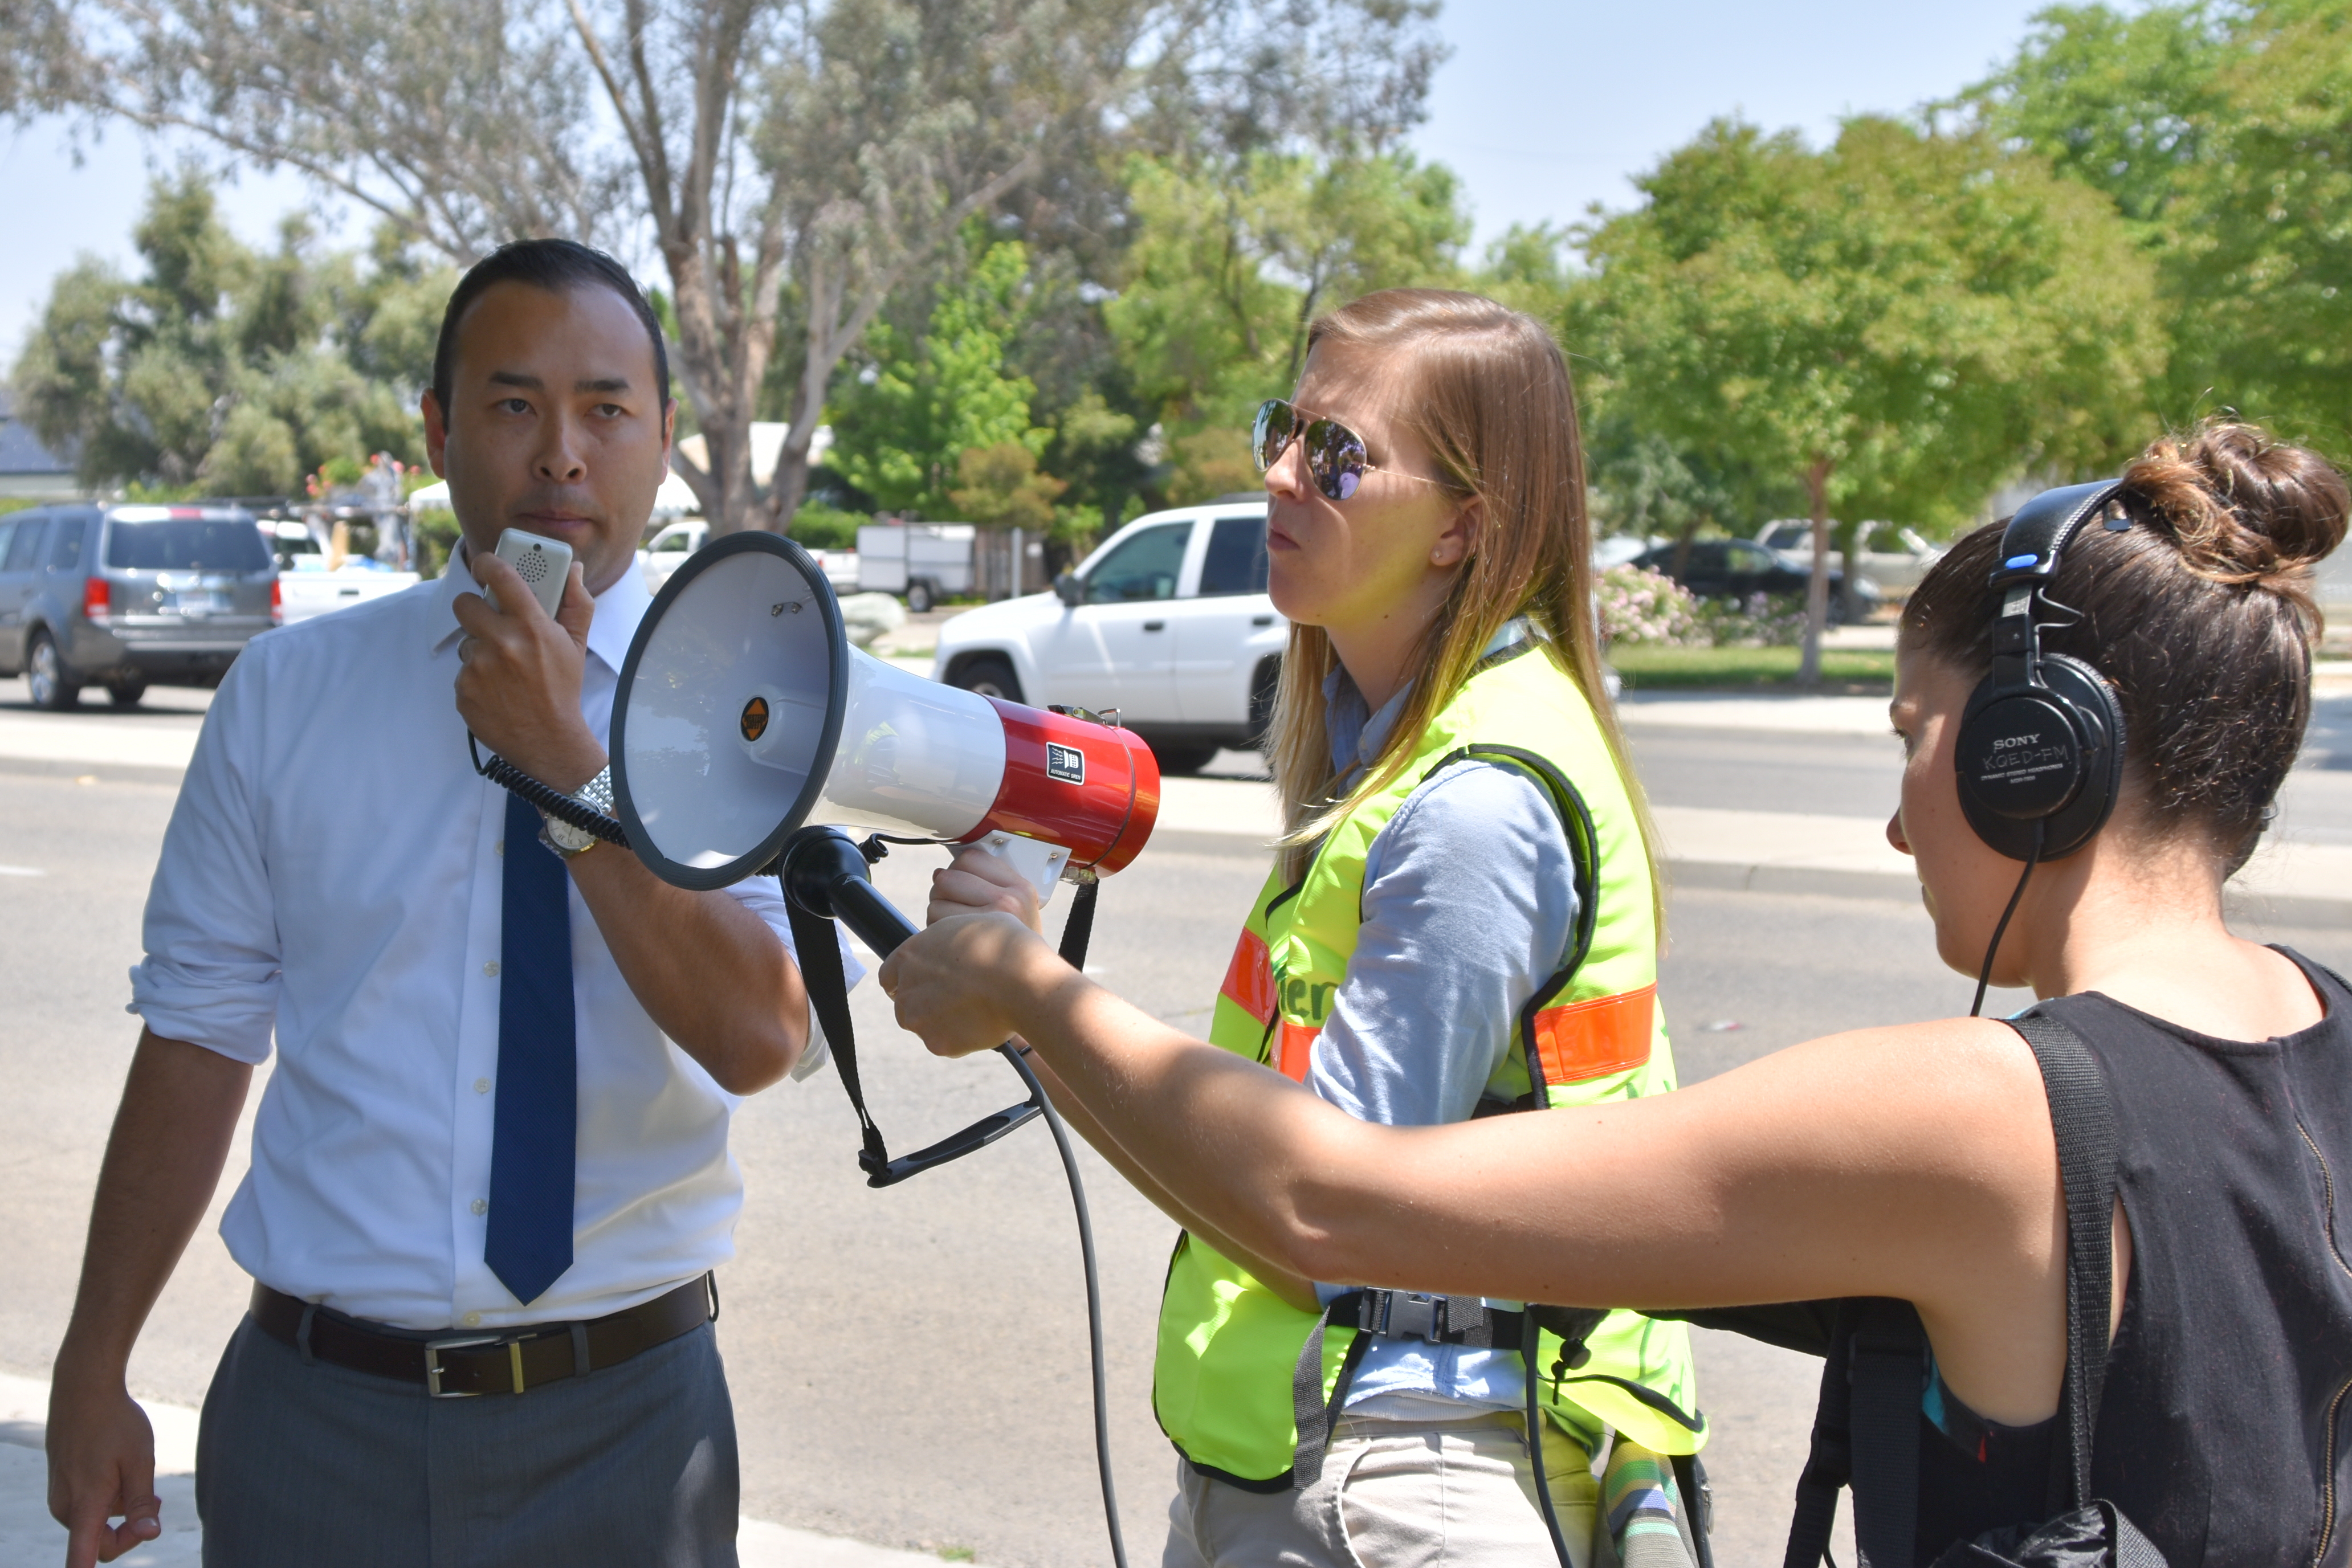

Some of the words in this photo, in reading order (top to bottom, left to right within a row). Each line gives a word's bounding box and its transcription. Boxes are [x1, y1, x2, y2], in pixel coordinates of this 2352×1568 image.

[1994, 733, 2040, 750] SONY
[1983, 745, 2068, 770] KQED-FM
[1050, 769, 1070, 777] AUTOMATIC
